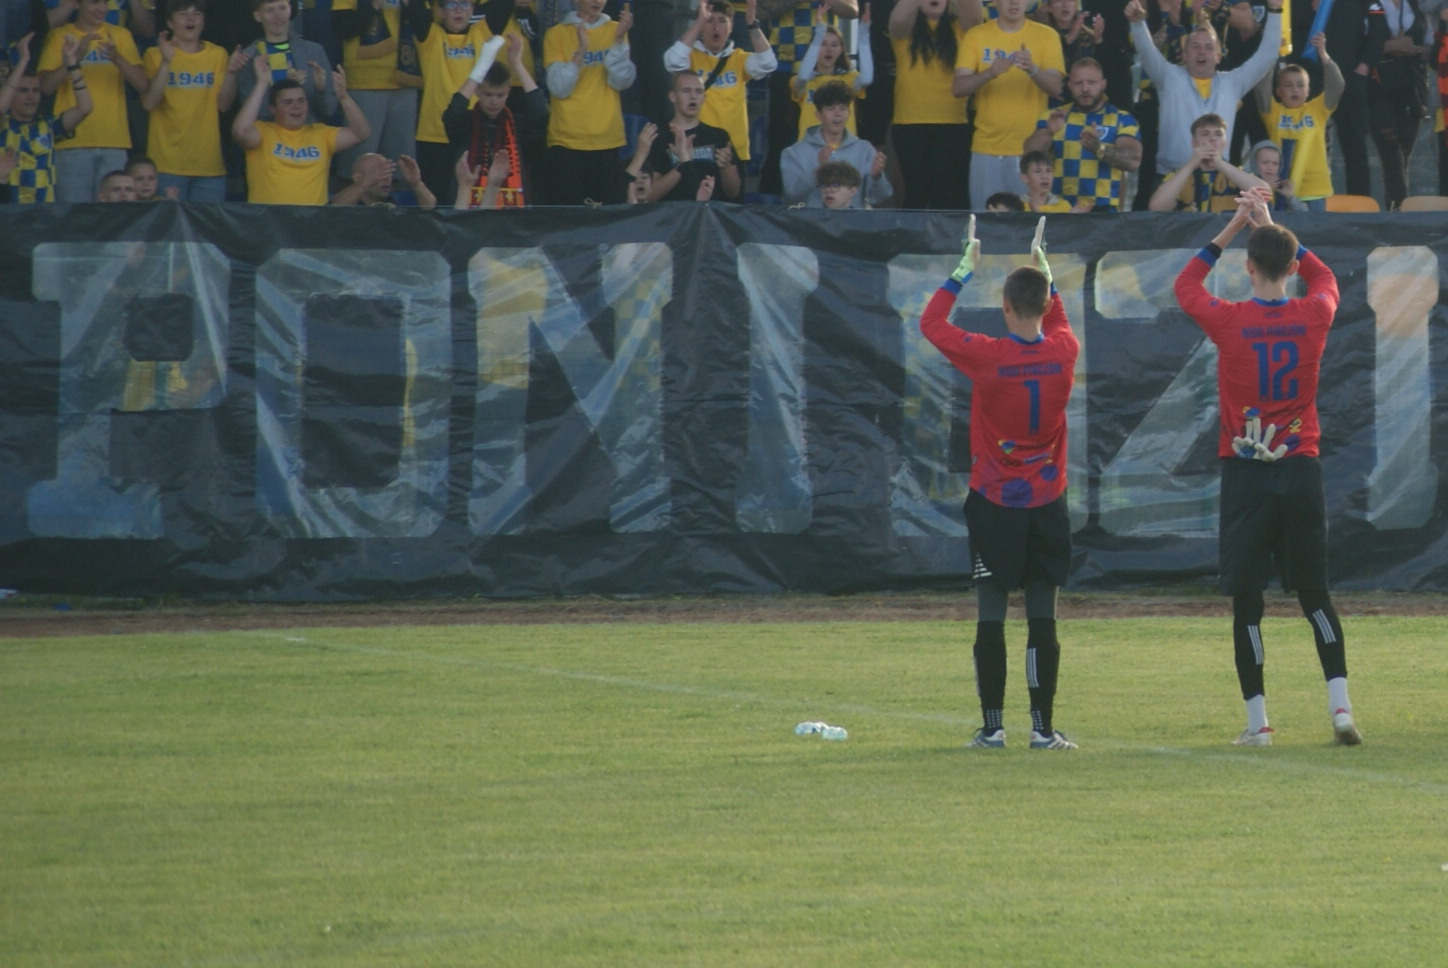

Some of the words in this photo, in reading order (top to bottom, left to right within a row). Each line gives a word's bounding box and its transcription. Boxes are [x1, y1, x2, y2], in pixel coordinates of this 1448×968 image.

[168, 72, 214, 86] 1946
[1252, 341, 1299, 401] 12
[1024, 379, 1041, 435] 1
